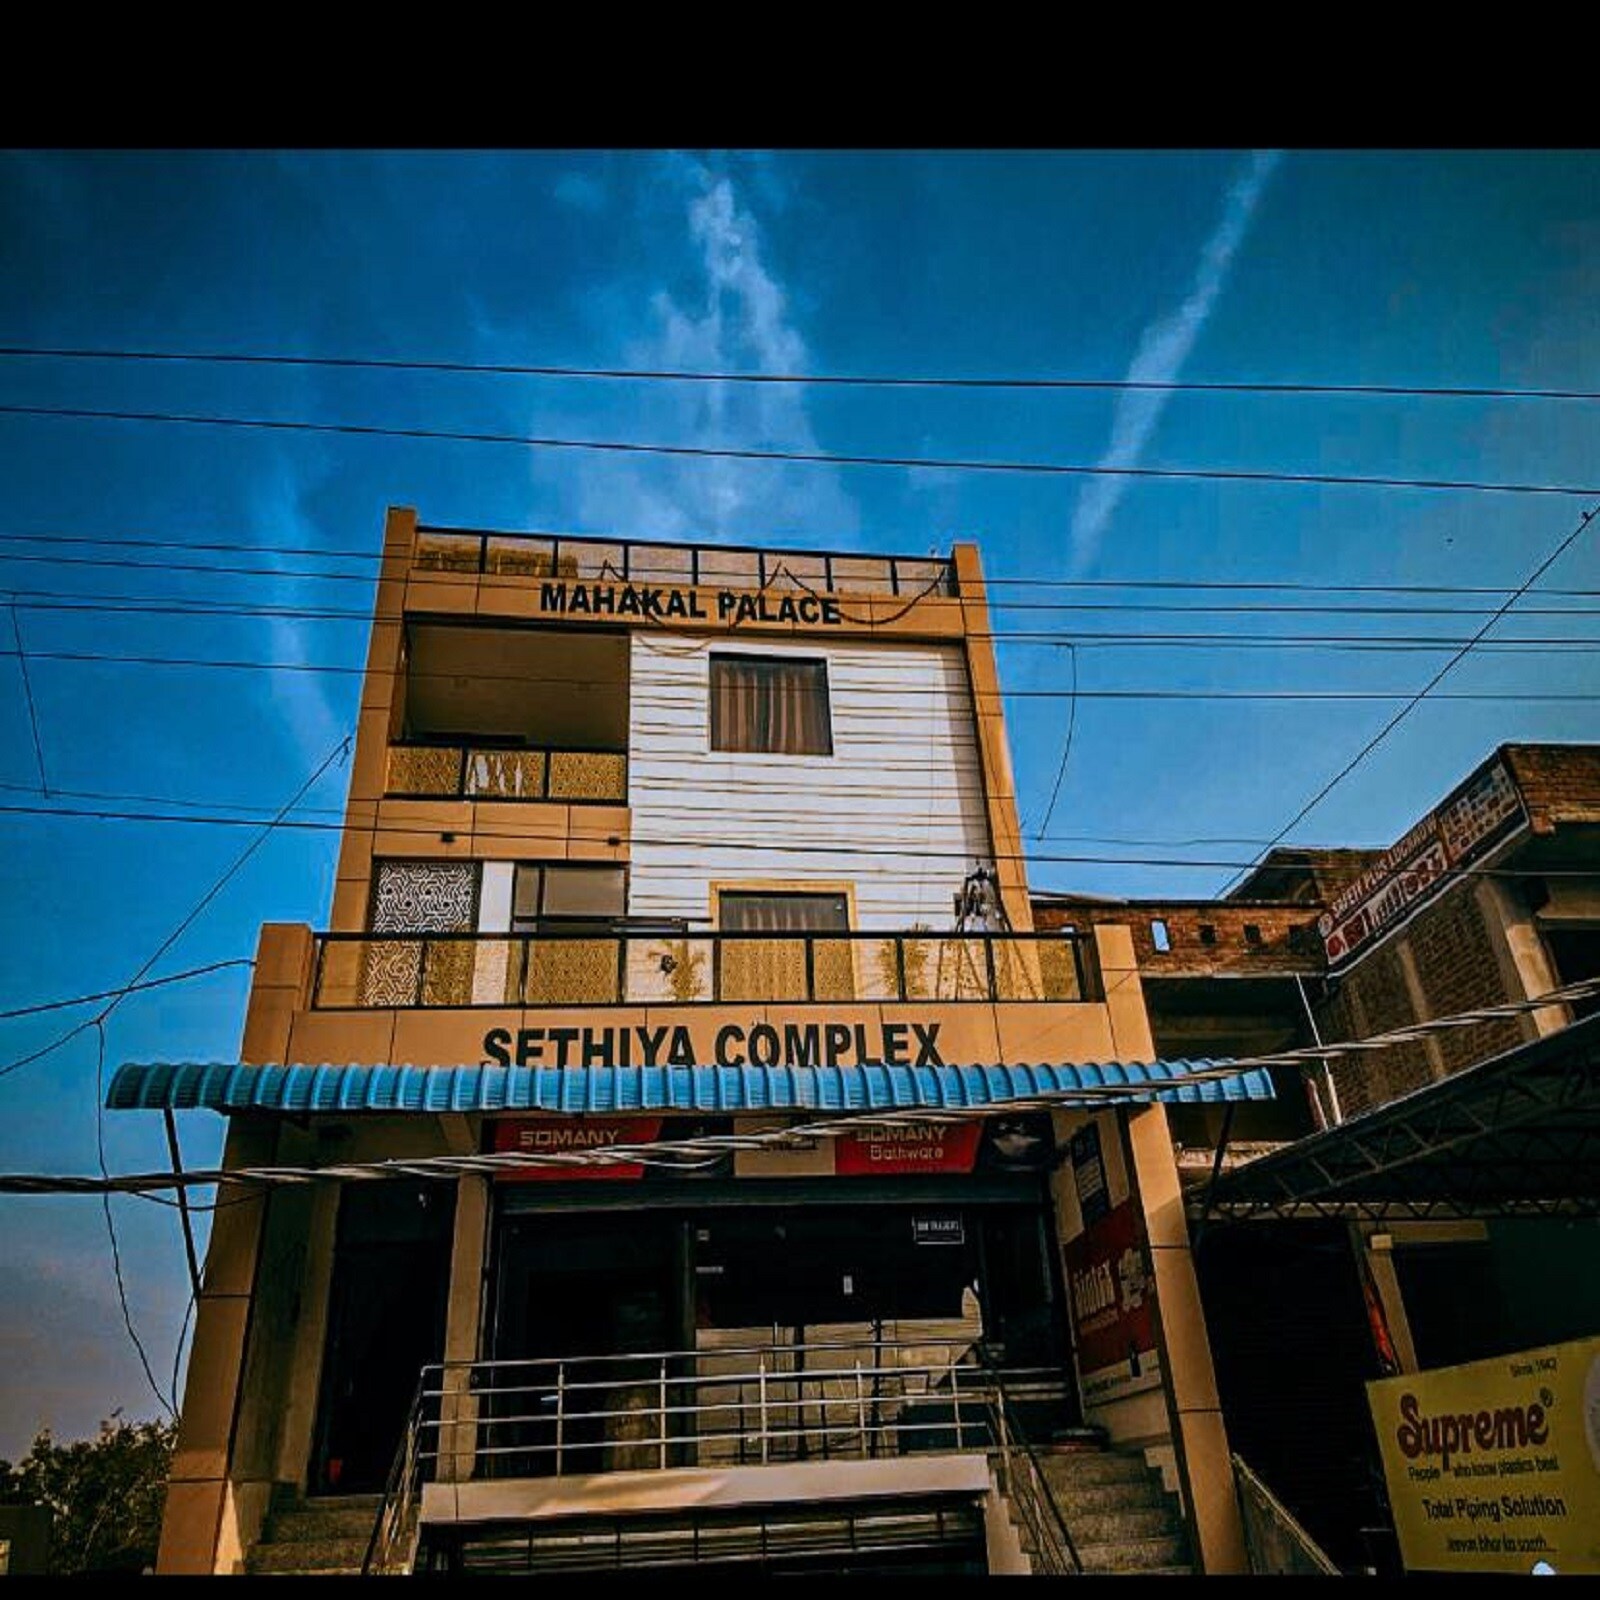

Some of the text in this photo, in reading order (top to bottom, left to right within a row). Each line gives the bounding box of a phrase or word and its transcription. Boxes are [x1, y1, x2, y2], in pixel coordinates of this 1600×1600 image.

[540, 582, 842, 626] MAHAKAL PALACE
[482, 1022, 945, 1067] SETHIYA COMPLEX
[519, 1127, 619, 1147] SOMANY
[1397, 1392, 1550, 1470] Supreme
[1423, 1494, 1566, 1523] Total Piping Solution
